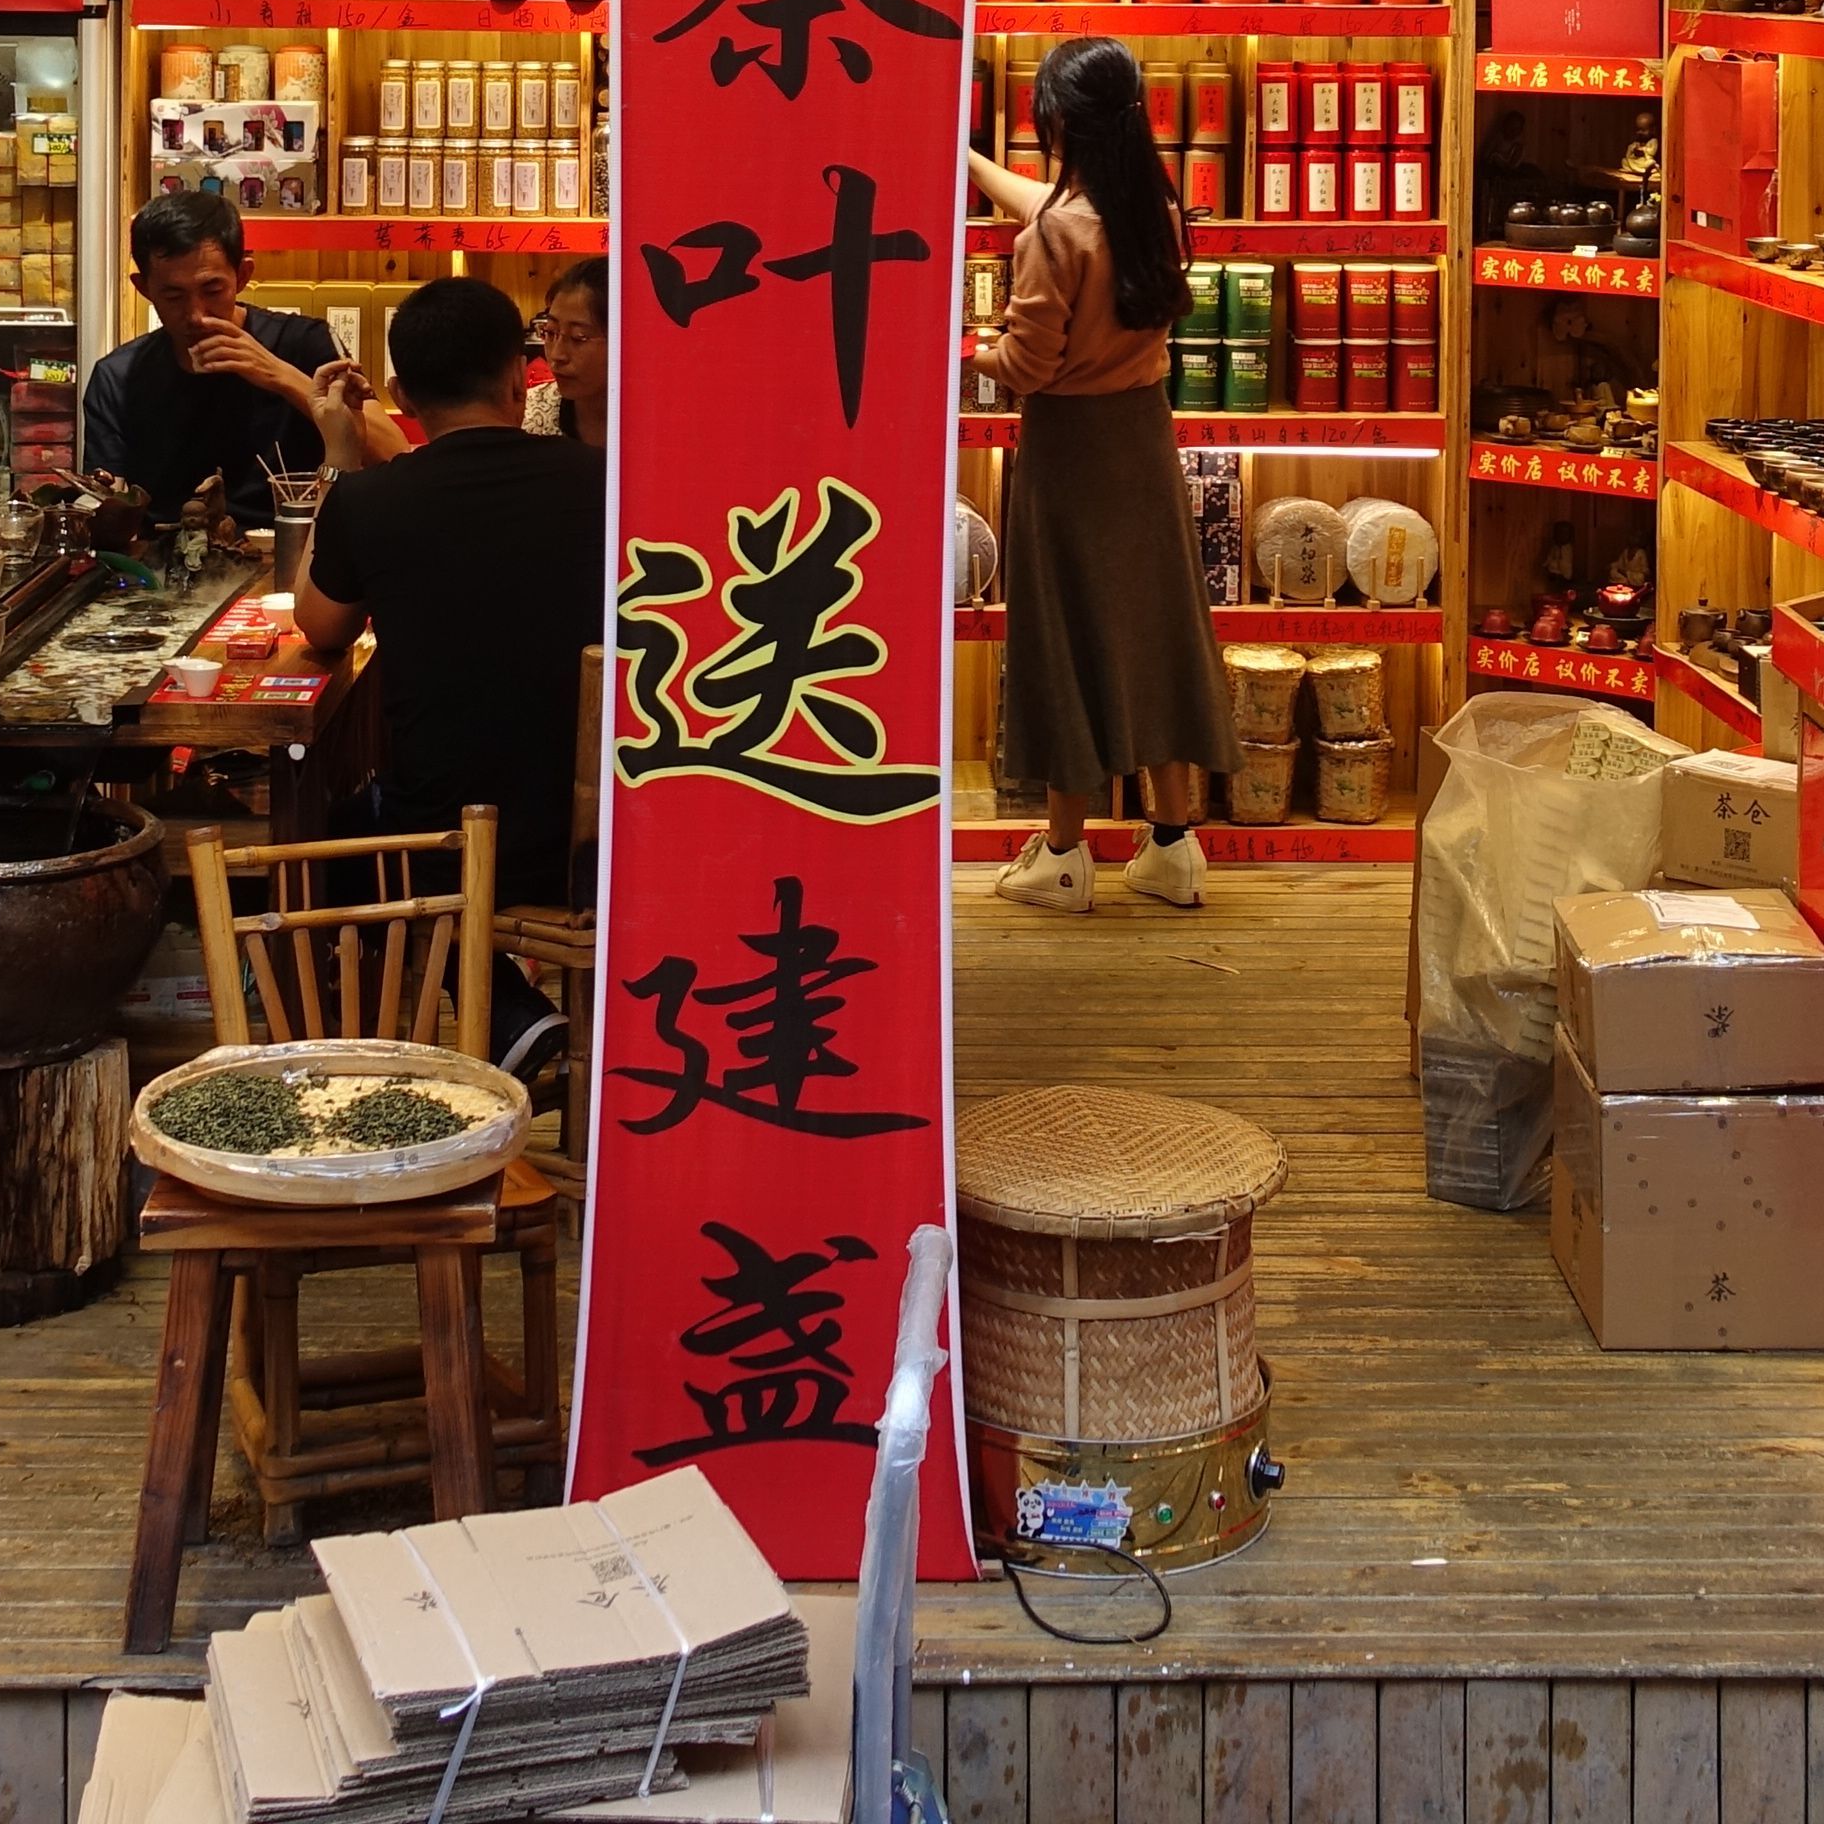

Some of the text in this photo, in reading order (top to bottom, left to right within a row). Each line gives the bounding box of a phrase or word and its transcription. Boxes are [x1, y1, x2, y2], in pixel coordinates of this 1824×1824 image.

[1484, 64, 1658, 92] 实价店 议价不卖
[1481, 256, 1654, 294] 实价店 议价不卖
[1478, 452, 1651, 495] 实价店 议价不卖
[1477, 647, 1649, 695] 实价店 议价不卖
[1713, 791, 1771, 826] 茶仓
[1705, 1271, 1737, 1304] 茶
